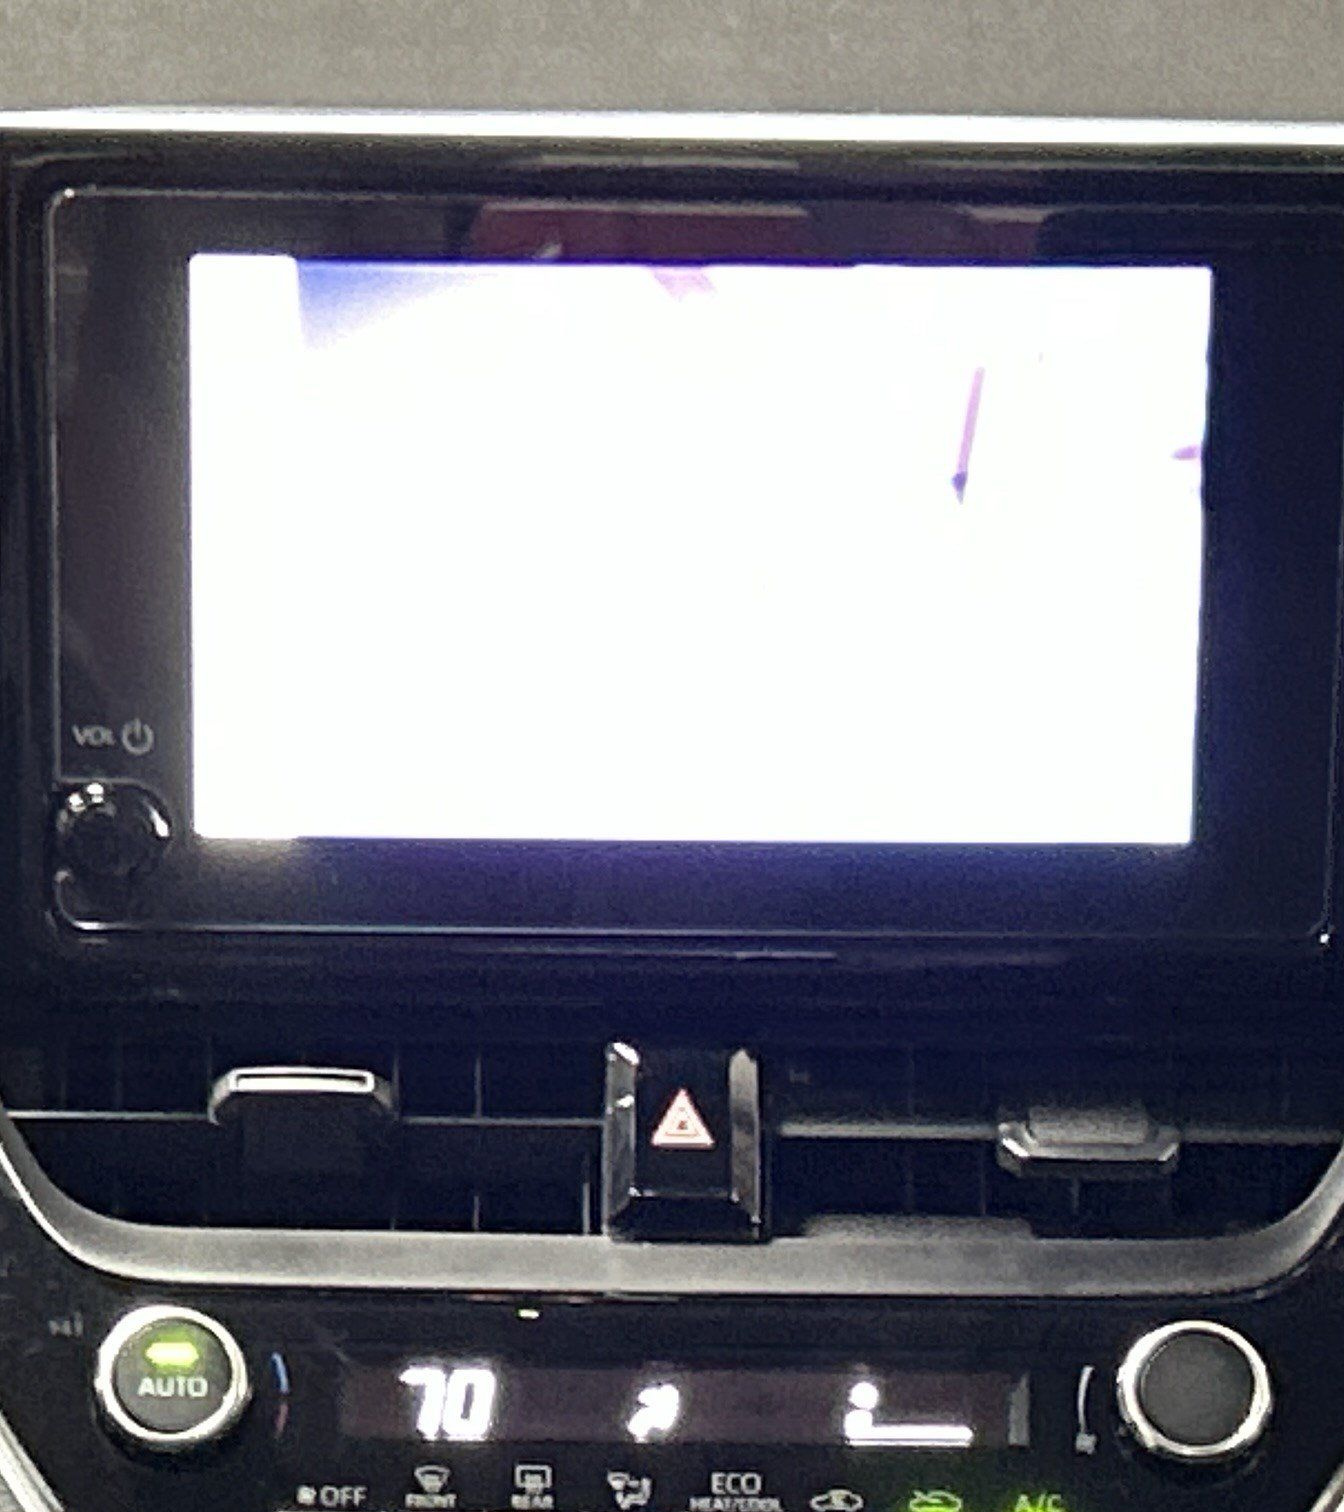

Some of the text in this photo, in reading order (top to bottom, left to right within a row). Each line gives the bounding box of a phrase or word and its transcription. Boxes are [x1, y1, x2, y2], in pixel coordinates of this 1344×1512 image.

[72, 724, 116, 747] VOL
[138, 1376, 208, 1398] AUTO
[397, 1364, 496, 1441] 70
[711, 1472, 763, 1495] ECO
[320, 1486, 368, 1507] OFF
[406, 1493, 456, 1509] FRONT
[511, 1494, 553, 1510] REAR
